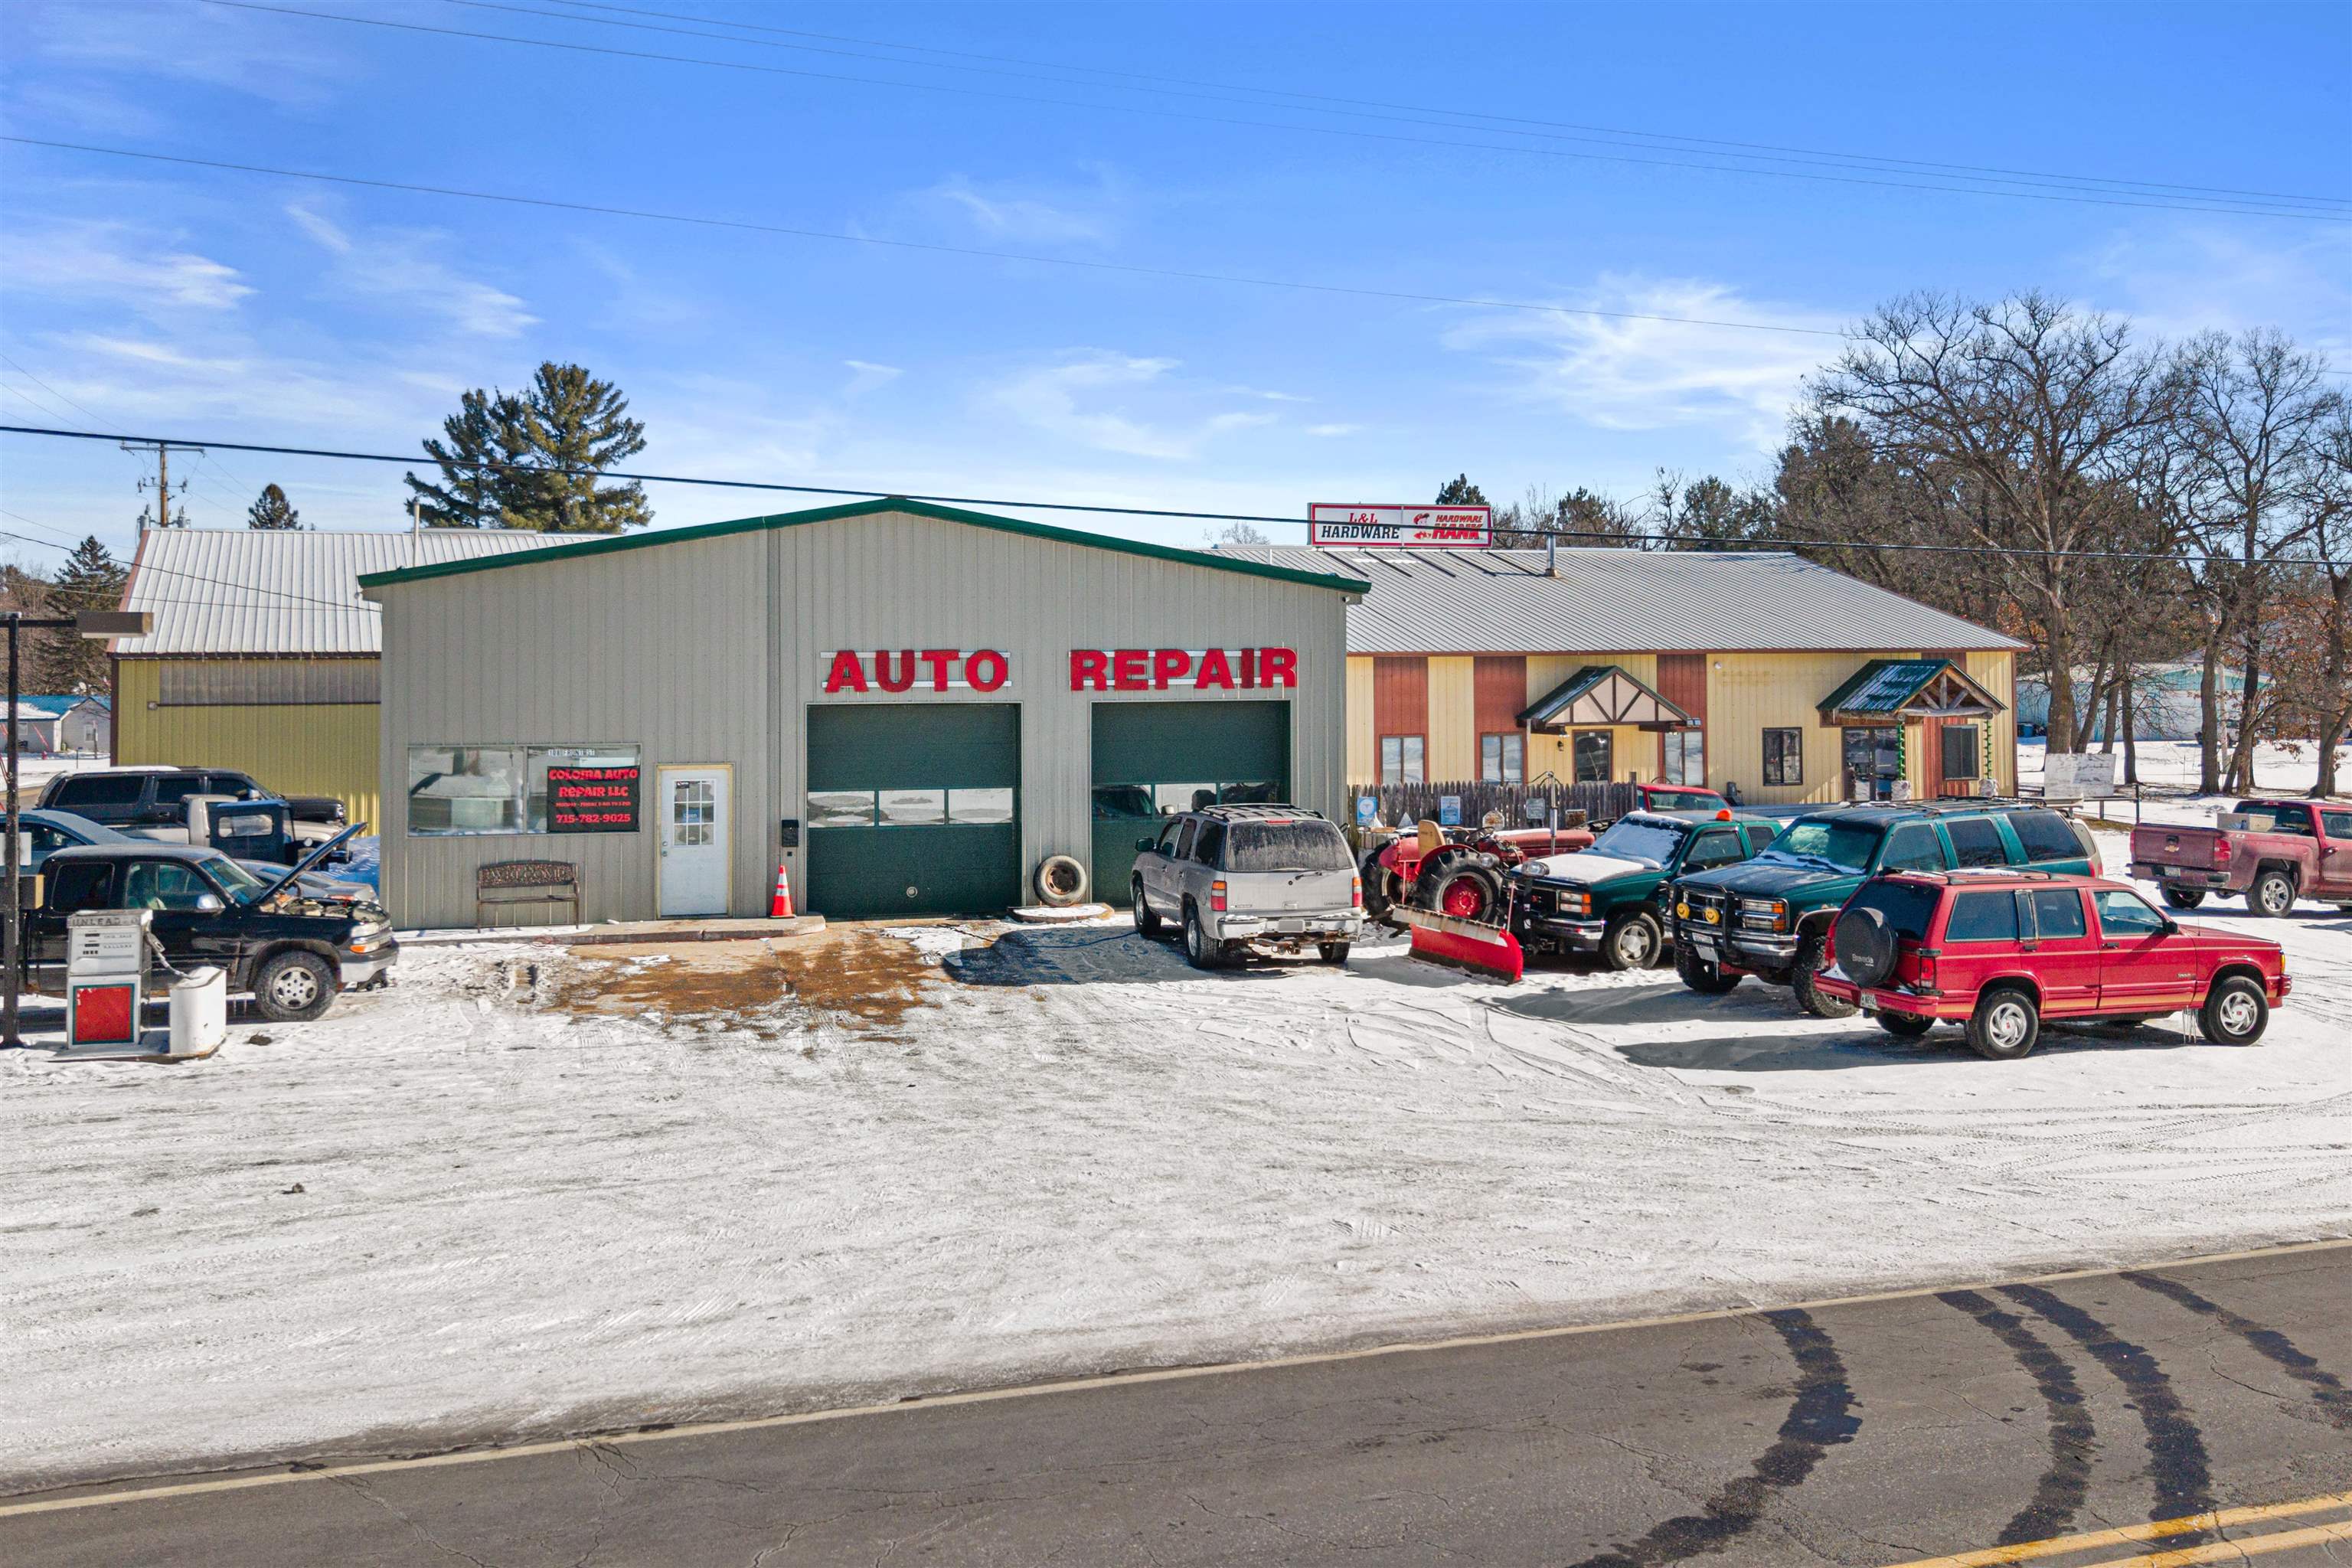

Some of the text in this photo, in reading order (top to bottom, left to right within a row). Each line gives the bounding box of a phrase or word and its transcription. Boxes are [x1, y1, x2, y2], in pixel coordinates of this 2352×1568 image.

[1348, 512, 1377, 524] L&L
[1436, 514, 1483, 523] HARDWARE
[1321, 525, 1400, 539] HARDWARE
[825, 647, 1298, 693] AUTO REPAIR
[605, 769, 639, 779] AUTO
[608, 786, 629, 796] LLC
[556, 814, 631, 823] 715-782-9025
